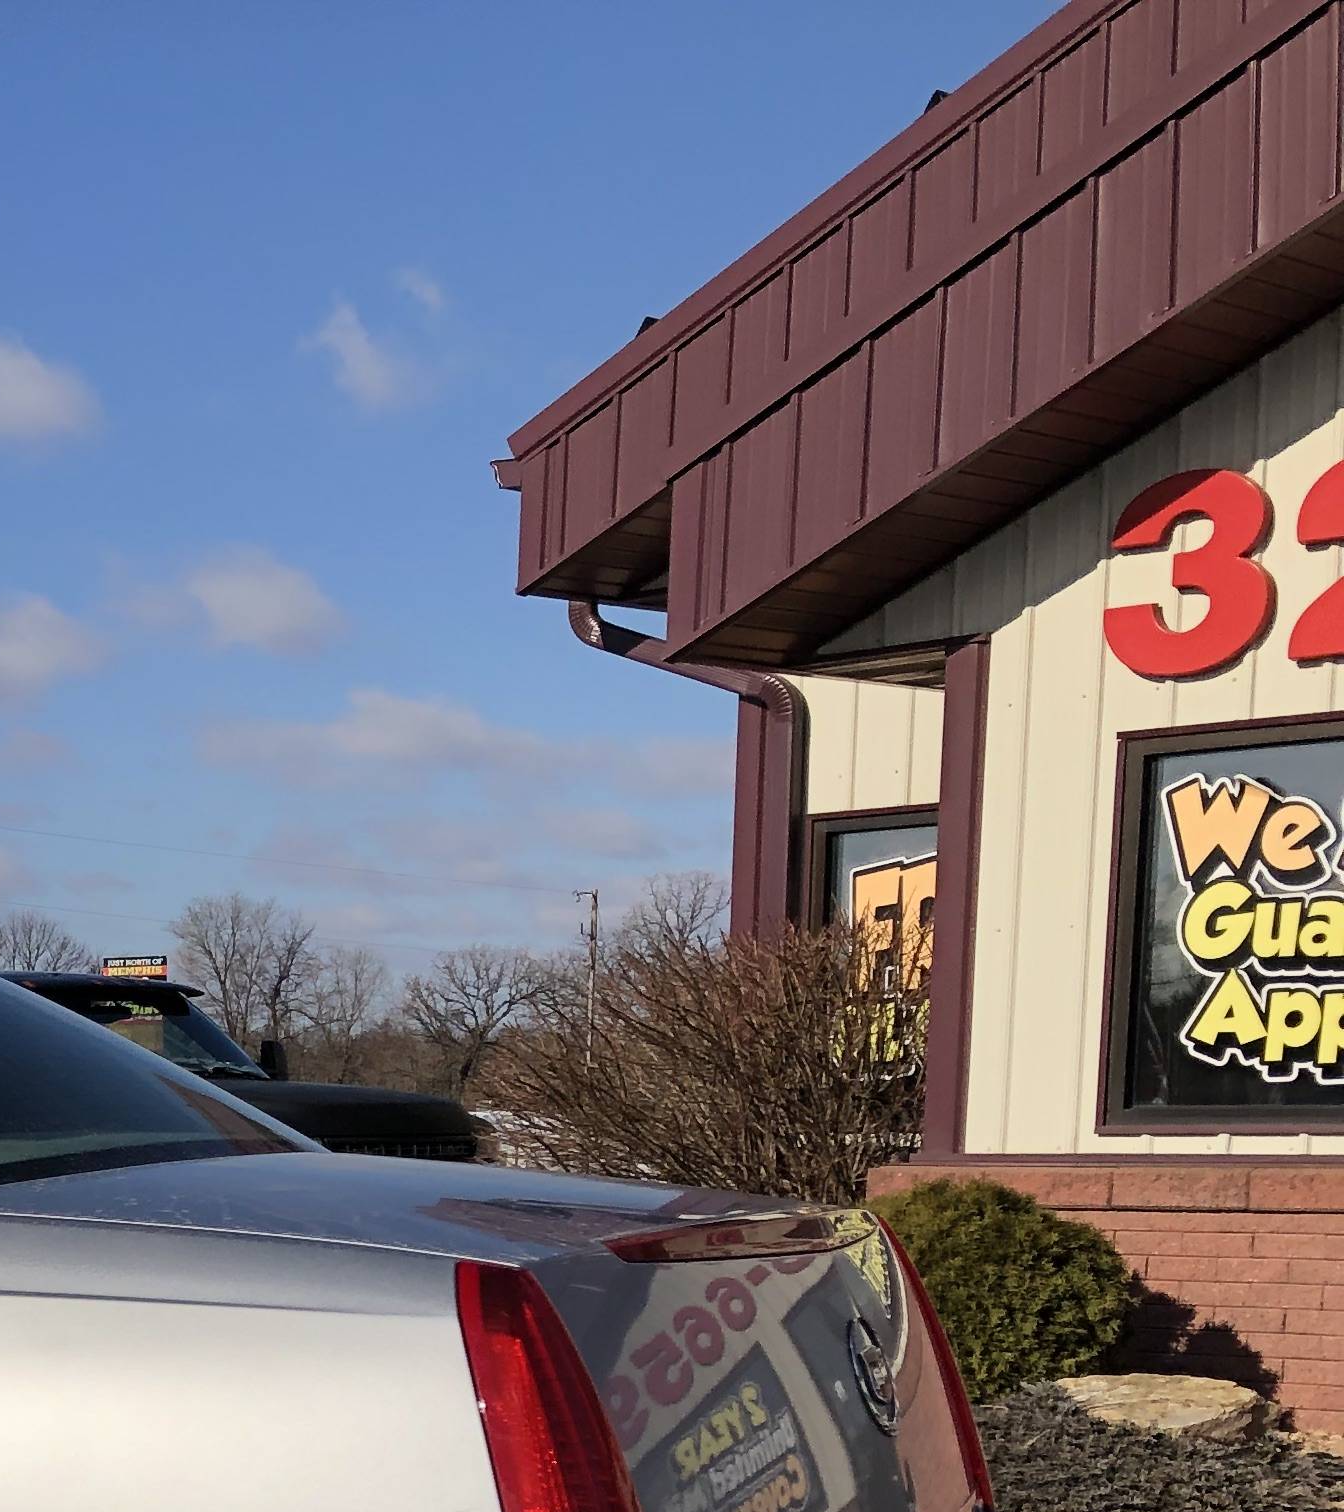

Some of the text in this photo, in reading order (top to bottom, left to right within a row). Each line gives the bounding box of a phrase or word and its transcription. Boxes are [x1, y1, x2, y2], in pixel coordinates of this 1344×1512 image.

[1168, 778, 1323, 880] We
[107, 959, 125, 967] JUST
[152, 957, 164, 965] OF
[107, 965, 162, 976] MEMPHIS
